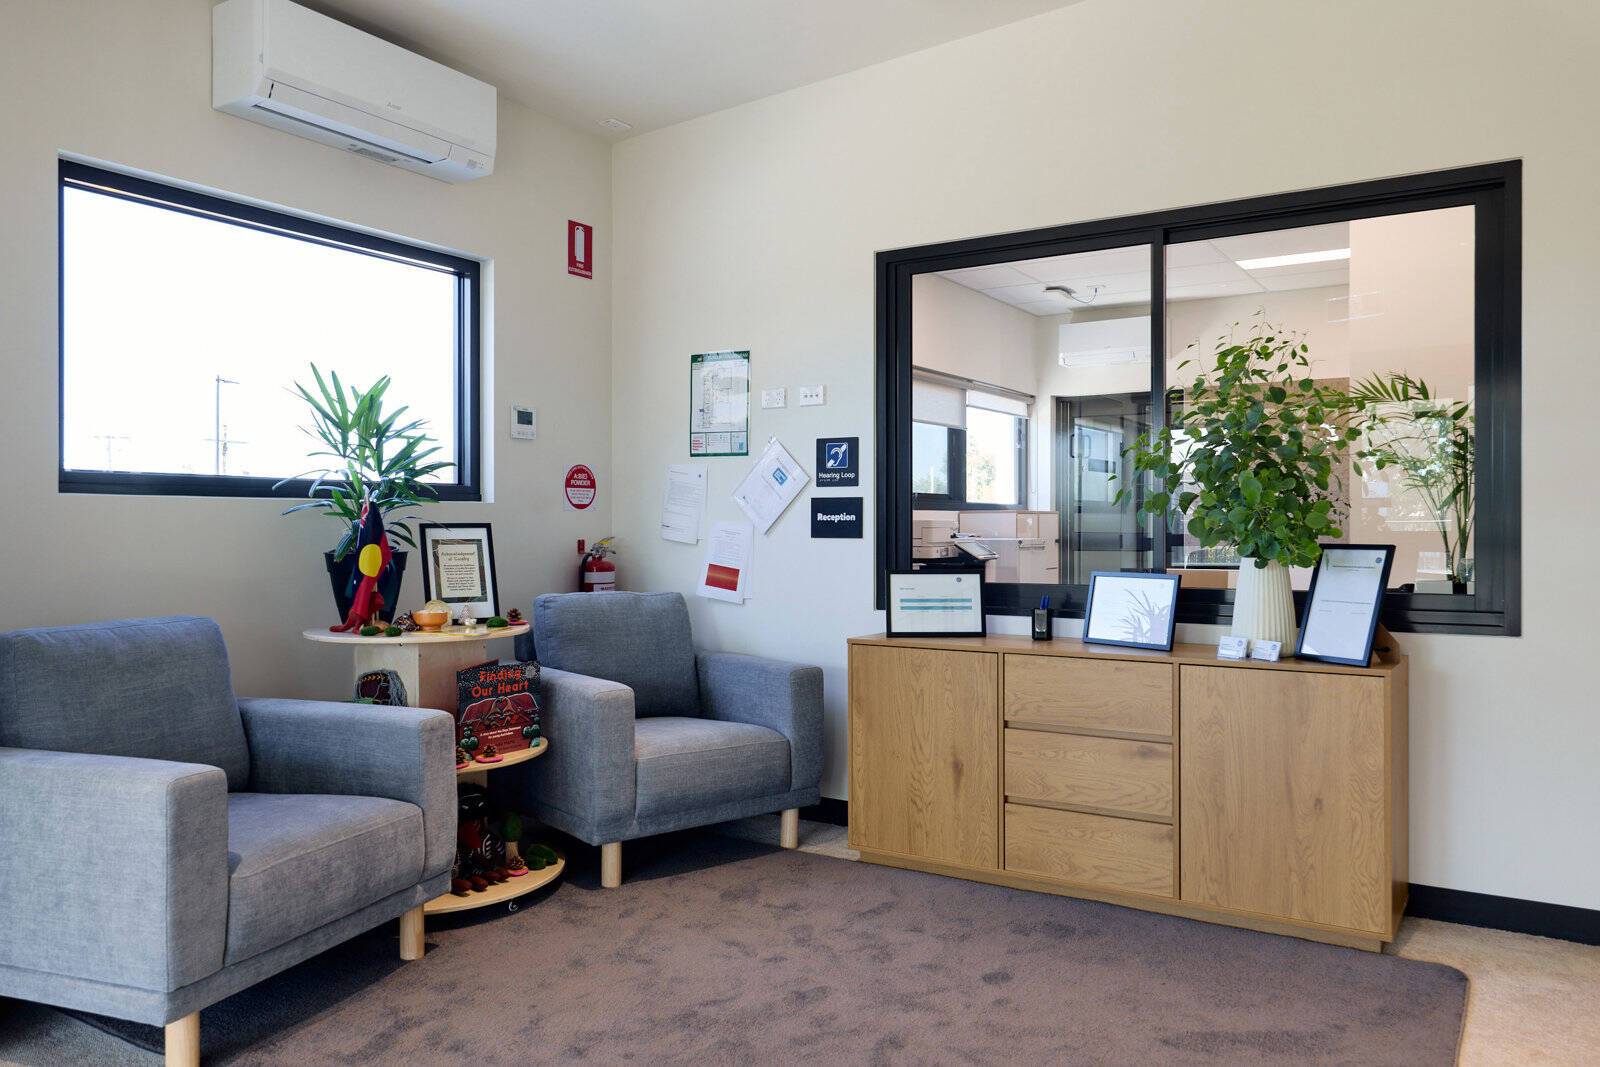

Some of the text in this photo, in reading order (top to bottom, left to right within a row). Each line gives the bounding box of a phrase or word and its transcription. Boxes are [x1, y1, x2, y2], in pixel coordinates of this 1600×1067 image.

[817, 512, 856, 523] Reception
[479, 669, 521, 683] Finding
[471, 680, 529, 698] Our Heart
